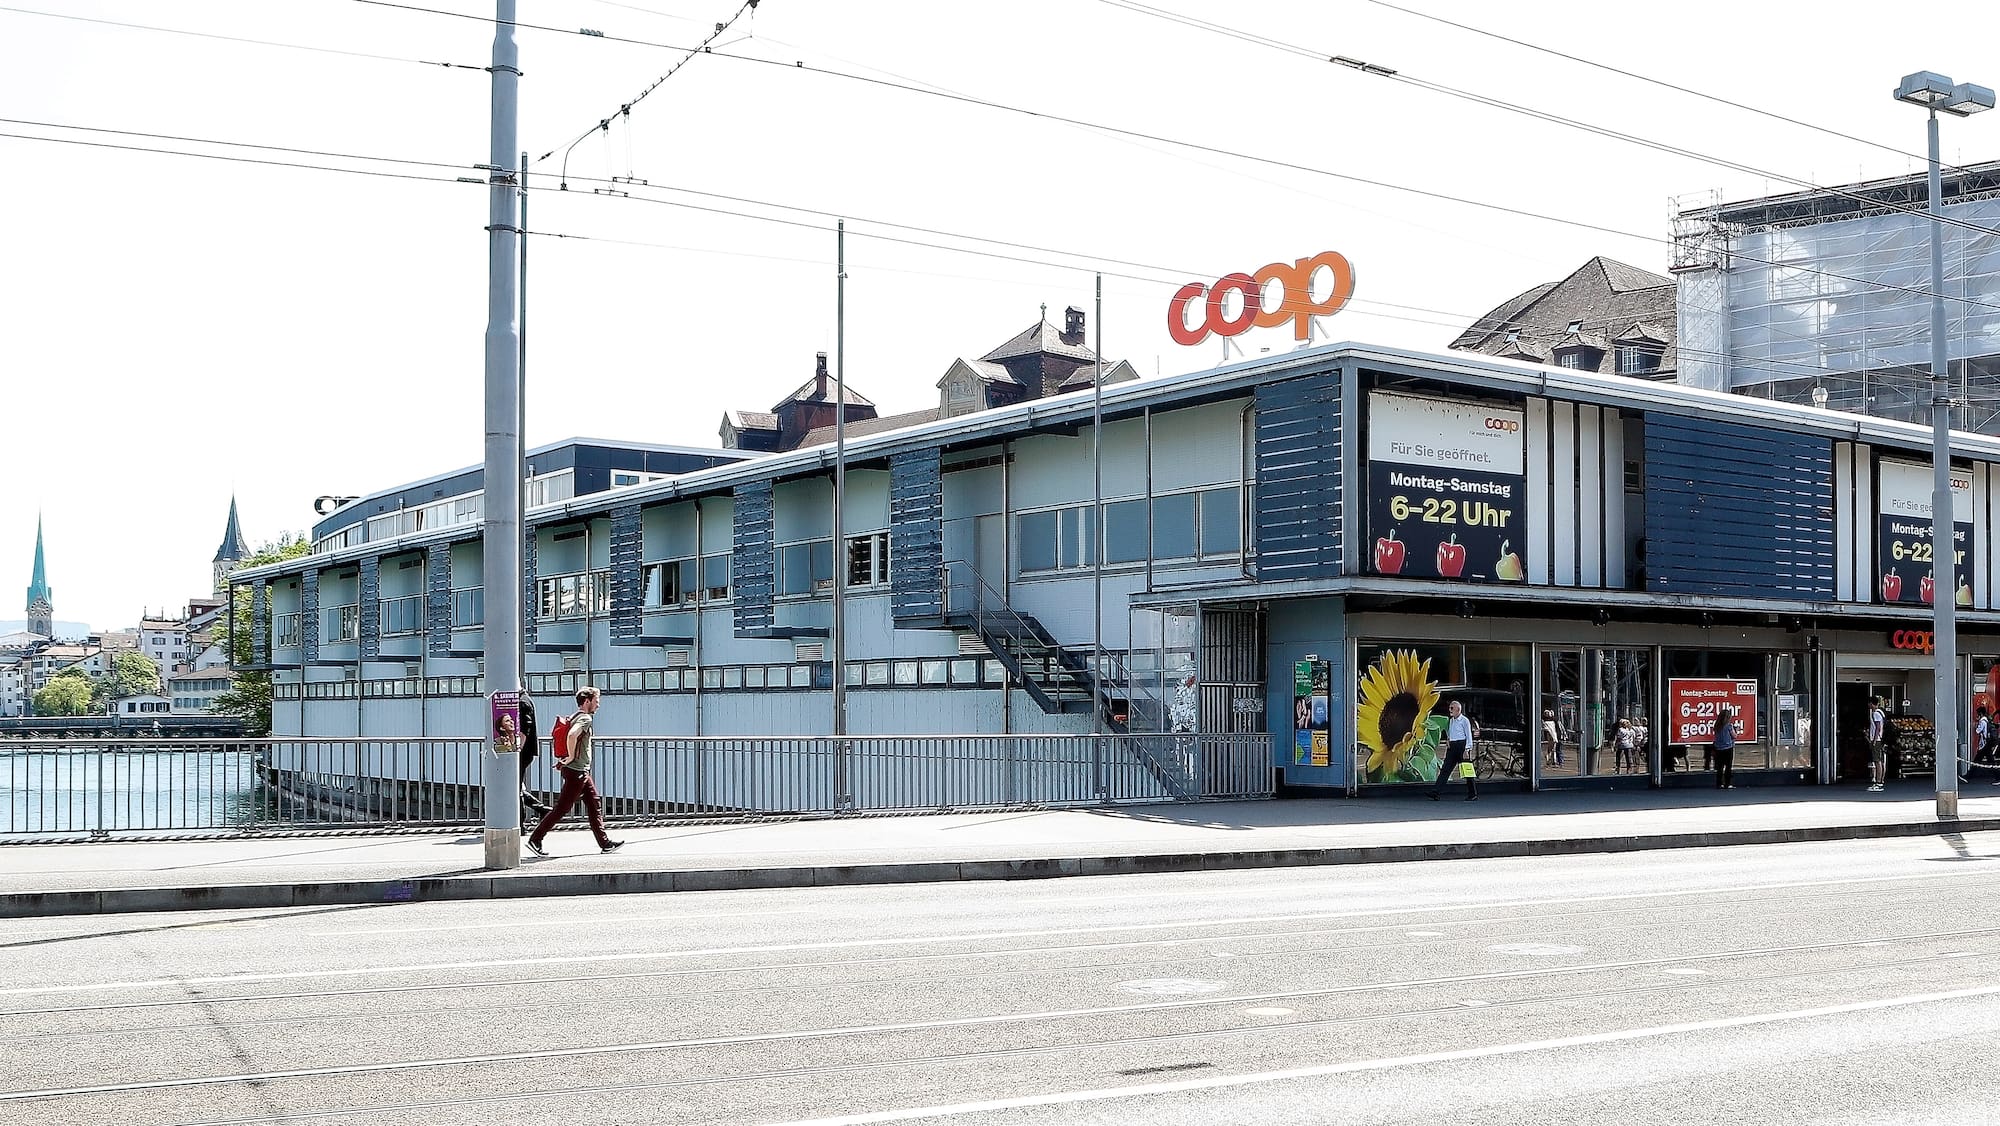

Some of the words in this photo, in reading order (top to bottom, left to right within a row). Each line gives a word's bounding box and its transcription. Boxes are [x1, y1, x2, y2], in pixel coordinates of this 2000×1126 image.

[1168, 251, 1353, 346] coop
[1485, 417, 1519, 434] coop
[1391, 442, 1412, 455] Für
[1415, 445, 1434, 458] Sie
[1437, 447, 1491, 464] geöffnet.
[1892, 499, 1905, 509] Für
[1907, 501, 1918, 510] Sie
[1463, 501, 1512, 528] Uhr
[1716, 702, 1742, 716] Uhr
